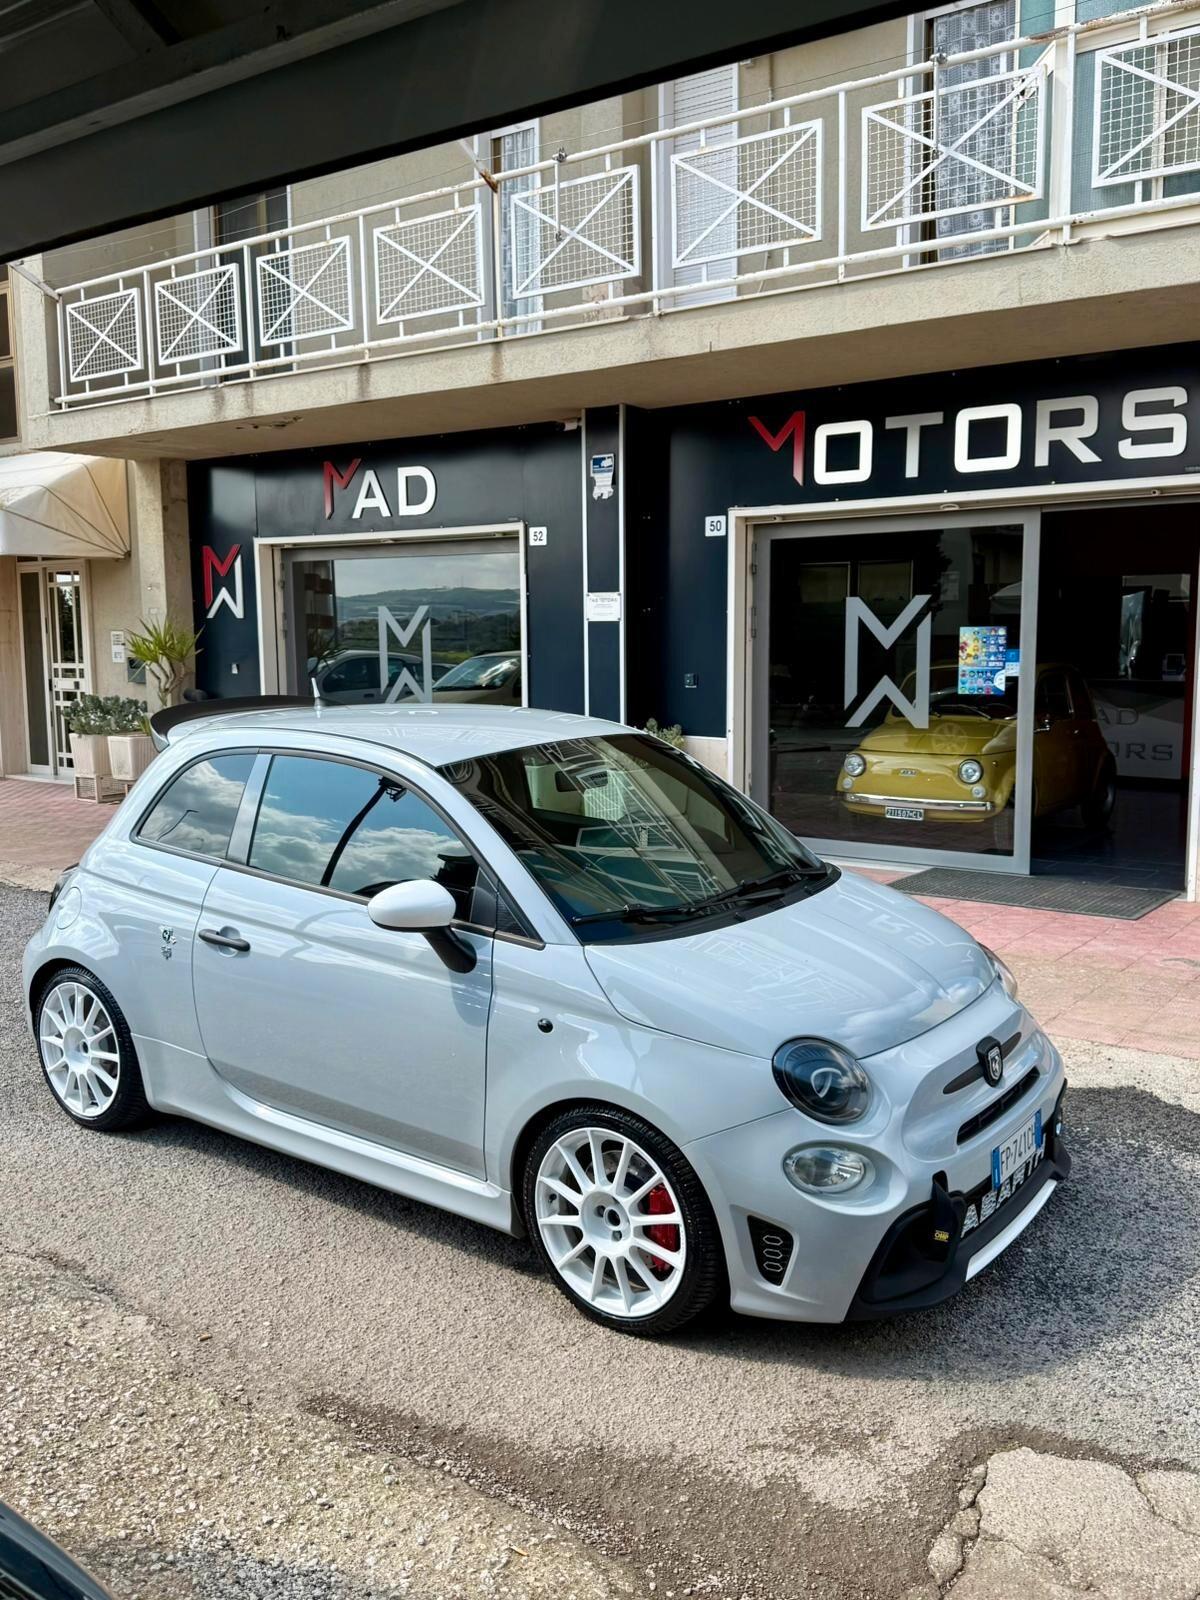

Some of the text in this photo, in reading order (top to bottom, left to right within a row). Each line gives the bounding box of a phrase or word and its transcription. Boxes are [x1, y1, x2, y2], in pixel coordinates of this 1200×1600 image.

[747, 385, 1188, 486] MOTORS
[323, 458, 437, 520] MAD
[532, 530, 544, 542] 52
[709, 520, 722, 532] 50
